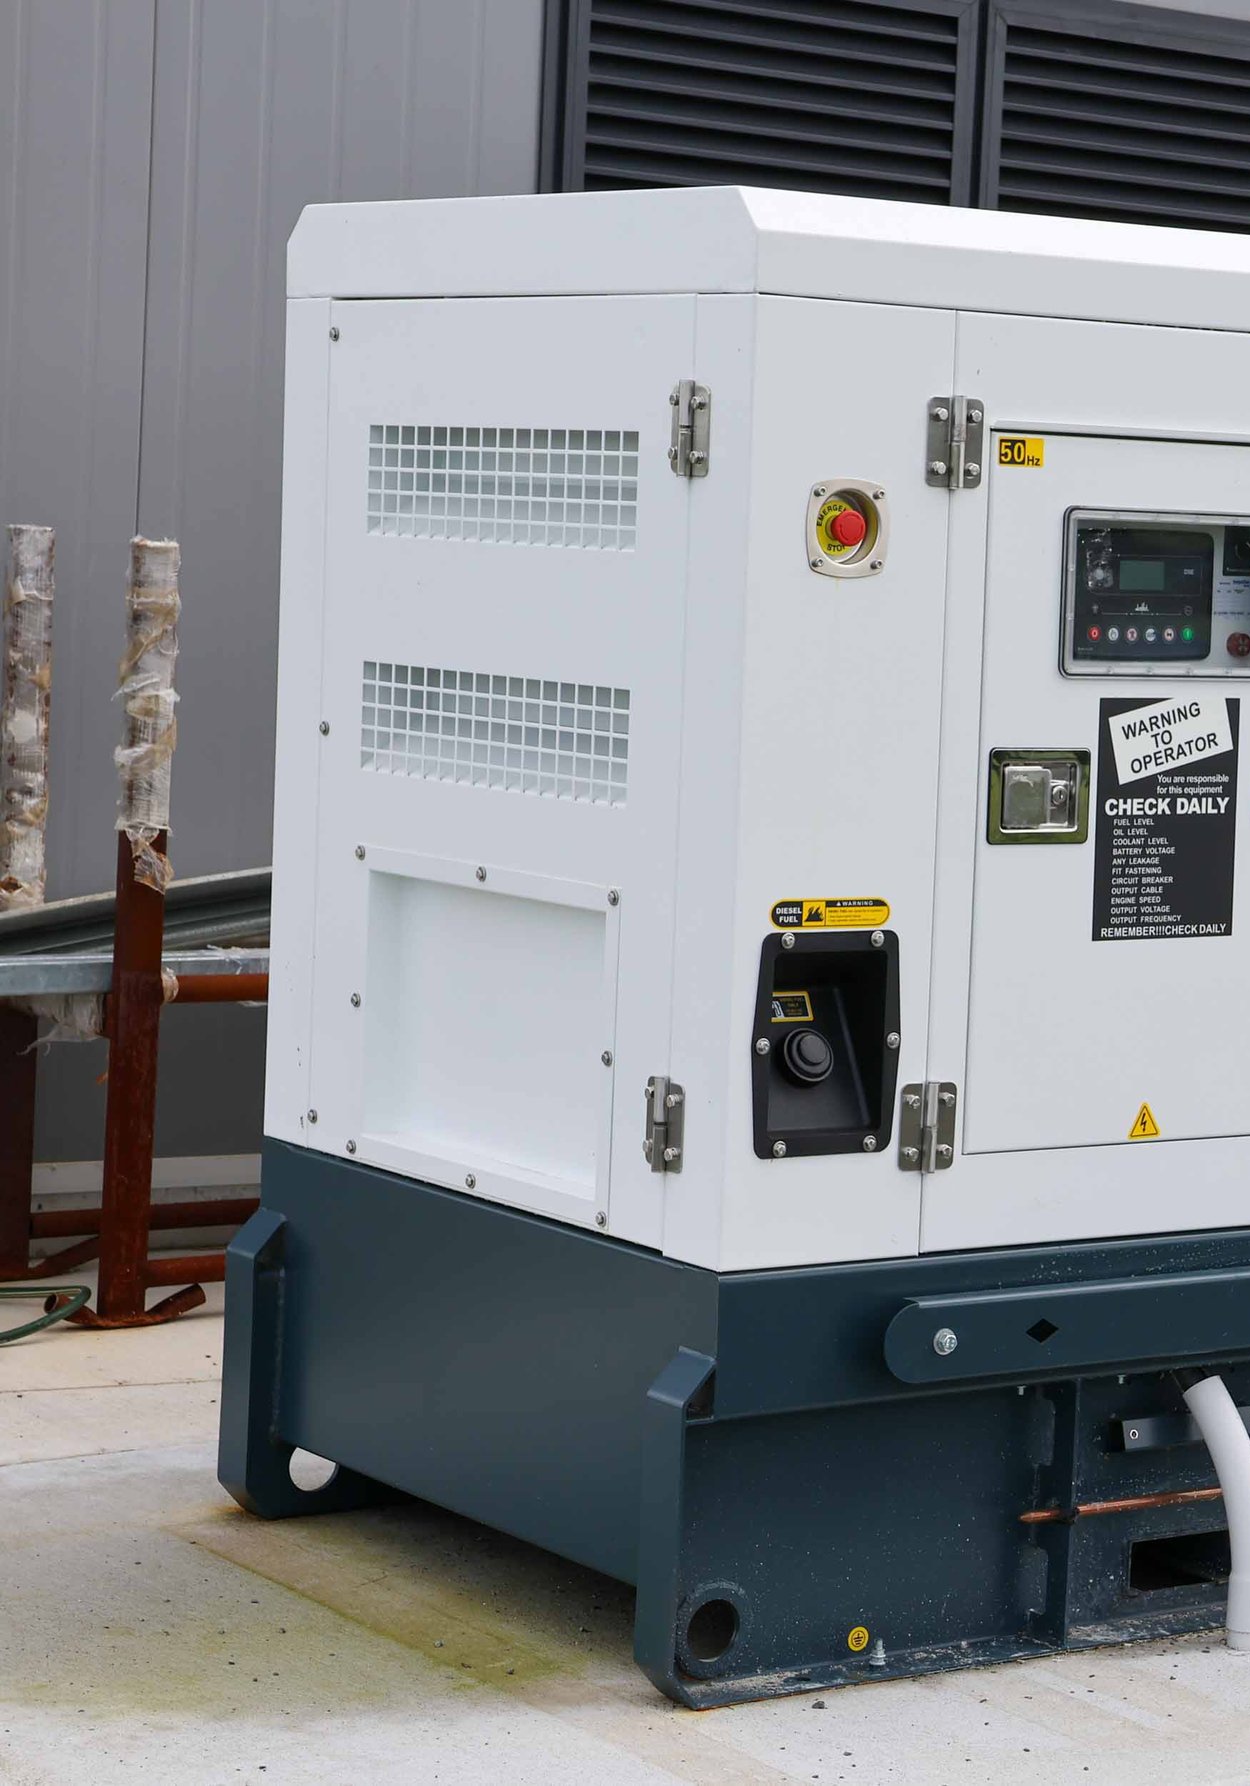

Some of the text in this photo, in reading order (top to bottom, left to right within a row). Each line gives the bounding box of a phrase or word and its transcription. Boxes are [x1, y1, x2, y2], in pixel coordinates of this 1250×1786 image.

[1000, 442, 1040, 466] 50 Hz
[1121, 702, 1201, 740] WARNING
[1151, 730, 1173, 748] TO
[1130, 733, 1219, 774] OPERATOR
[1157, 774, 1172, 784] You
[1186, 774, 1230, 786] responsible
[1157, 785, 1223, 796] for this equipment
[1104, 797, 1230, 816] CHECK DAILY
[1113, 818, 1155, 826] FUEL LEVEL
[1113, 828, 1149, 836] OIL LEVEL
[1112, 837, 1169, 846] COOLANT LEVEL
[1112, 846, 1176, 856] BATTERY VOLTAGE
[1112, 857, 1160, 866] ANY LEAKAGE
[1111, 866, 1162, 876] FIT FASTENING
[1111, 876, 1174, 885] CIRCUIT BREAKER
[1111, 886, 1164, 895] OUTPUT CABLE
[1110, 896, 1162, 905] ENGINE SPEED
[776, 907, 803, 915] DIESEL
[1110, 905, 1171, 915] OUTPUT VOLTAGE
[779, 915, 799, 924] FUEL
[1110, 914, 1182, 925] OUTPUT FREQUENCY
[1100, 923, 1227, 938] REMEMBER!!!CHECK DAILY
